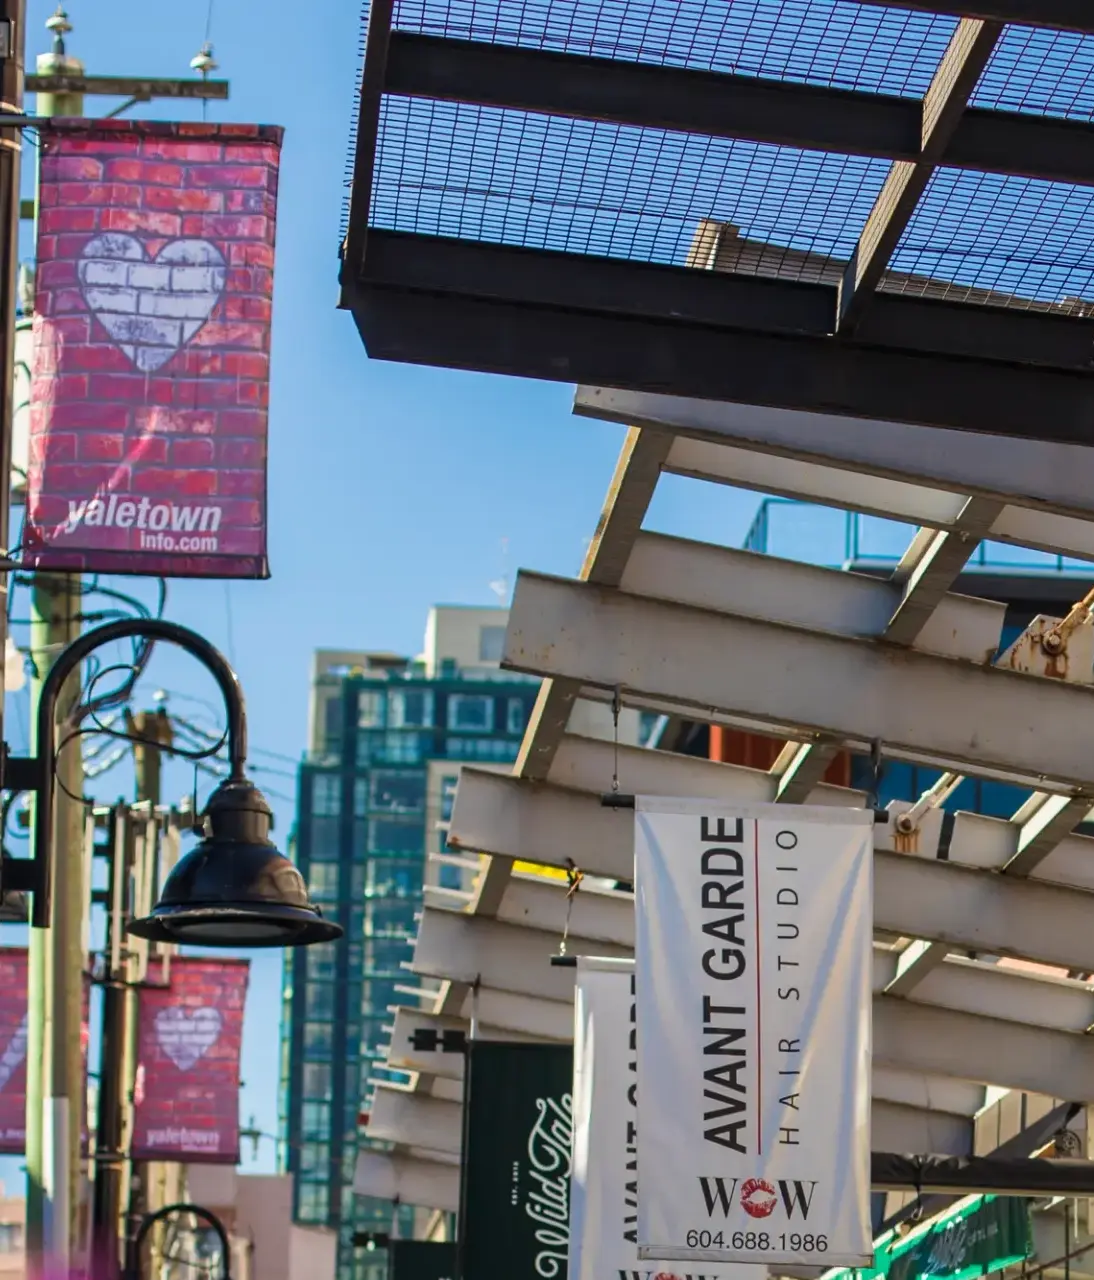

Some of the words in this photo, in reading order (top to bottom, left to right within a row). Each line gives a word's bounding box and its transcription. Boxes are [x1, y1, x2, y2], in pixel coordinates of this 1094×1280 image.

[64, 493, 222, 534] yaletown
[140, 530, 218, 551] info.com
[700, 816, 746, 981] GARDE
[775, 829, 800, 1001] STUDIO
[703, 995, 746, 1155] AVANT
[778, 1038, 800, 1145] HAIR
[686, 1229, 828, 1253] 604.688.1986
